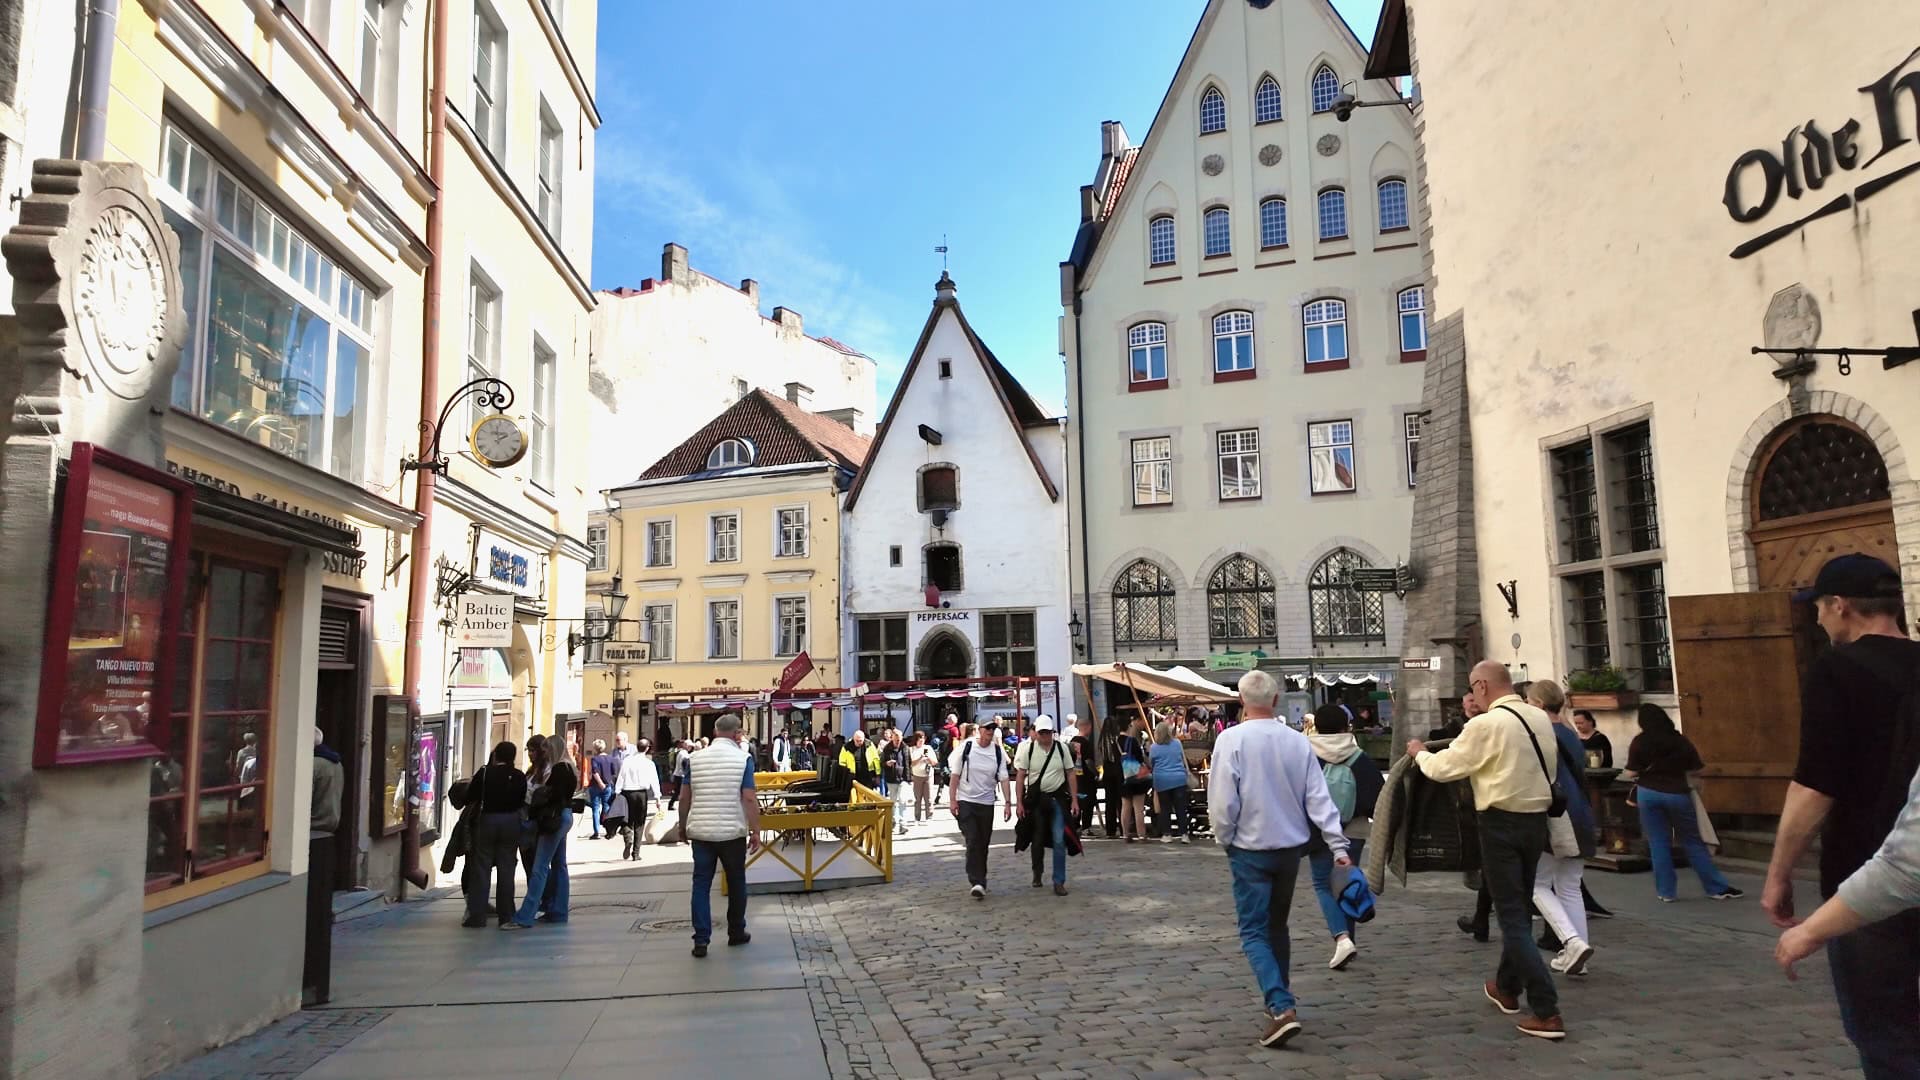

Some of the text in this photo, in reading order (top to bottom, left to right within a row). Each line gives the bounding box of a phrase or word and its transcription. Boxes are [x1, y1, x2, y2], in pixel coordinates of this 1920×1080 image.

[1722, 117, 1861, 223] Olde
[466, 602, 507, 615] Baltic
[917, 611, 969, 622] PEPPERSACK
[461, 617, 509, 630] Amber
[606, 649, 626, 660] VANA
[96, 659, 155, 672] TANGO NUEVO TRIO
